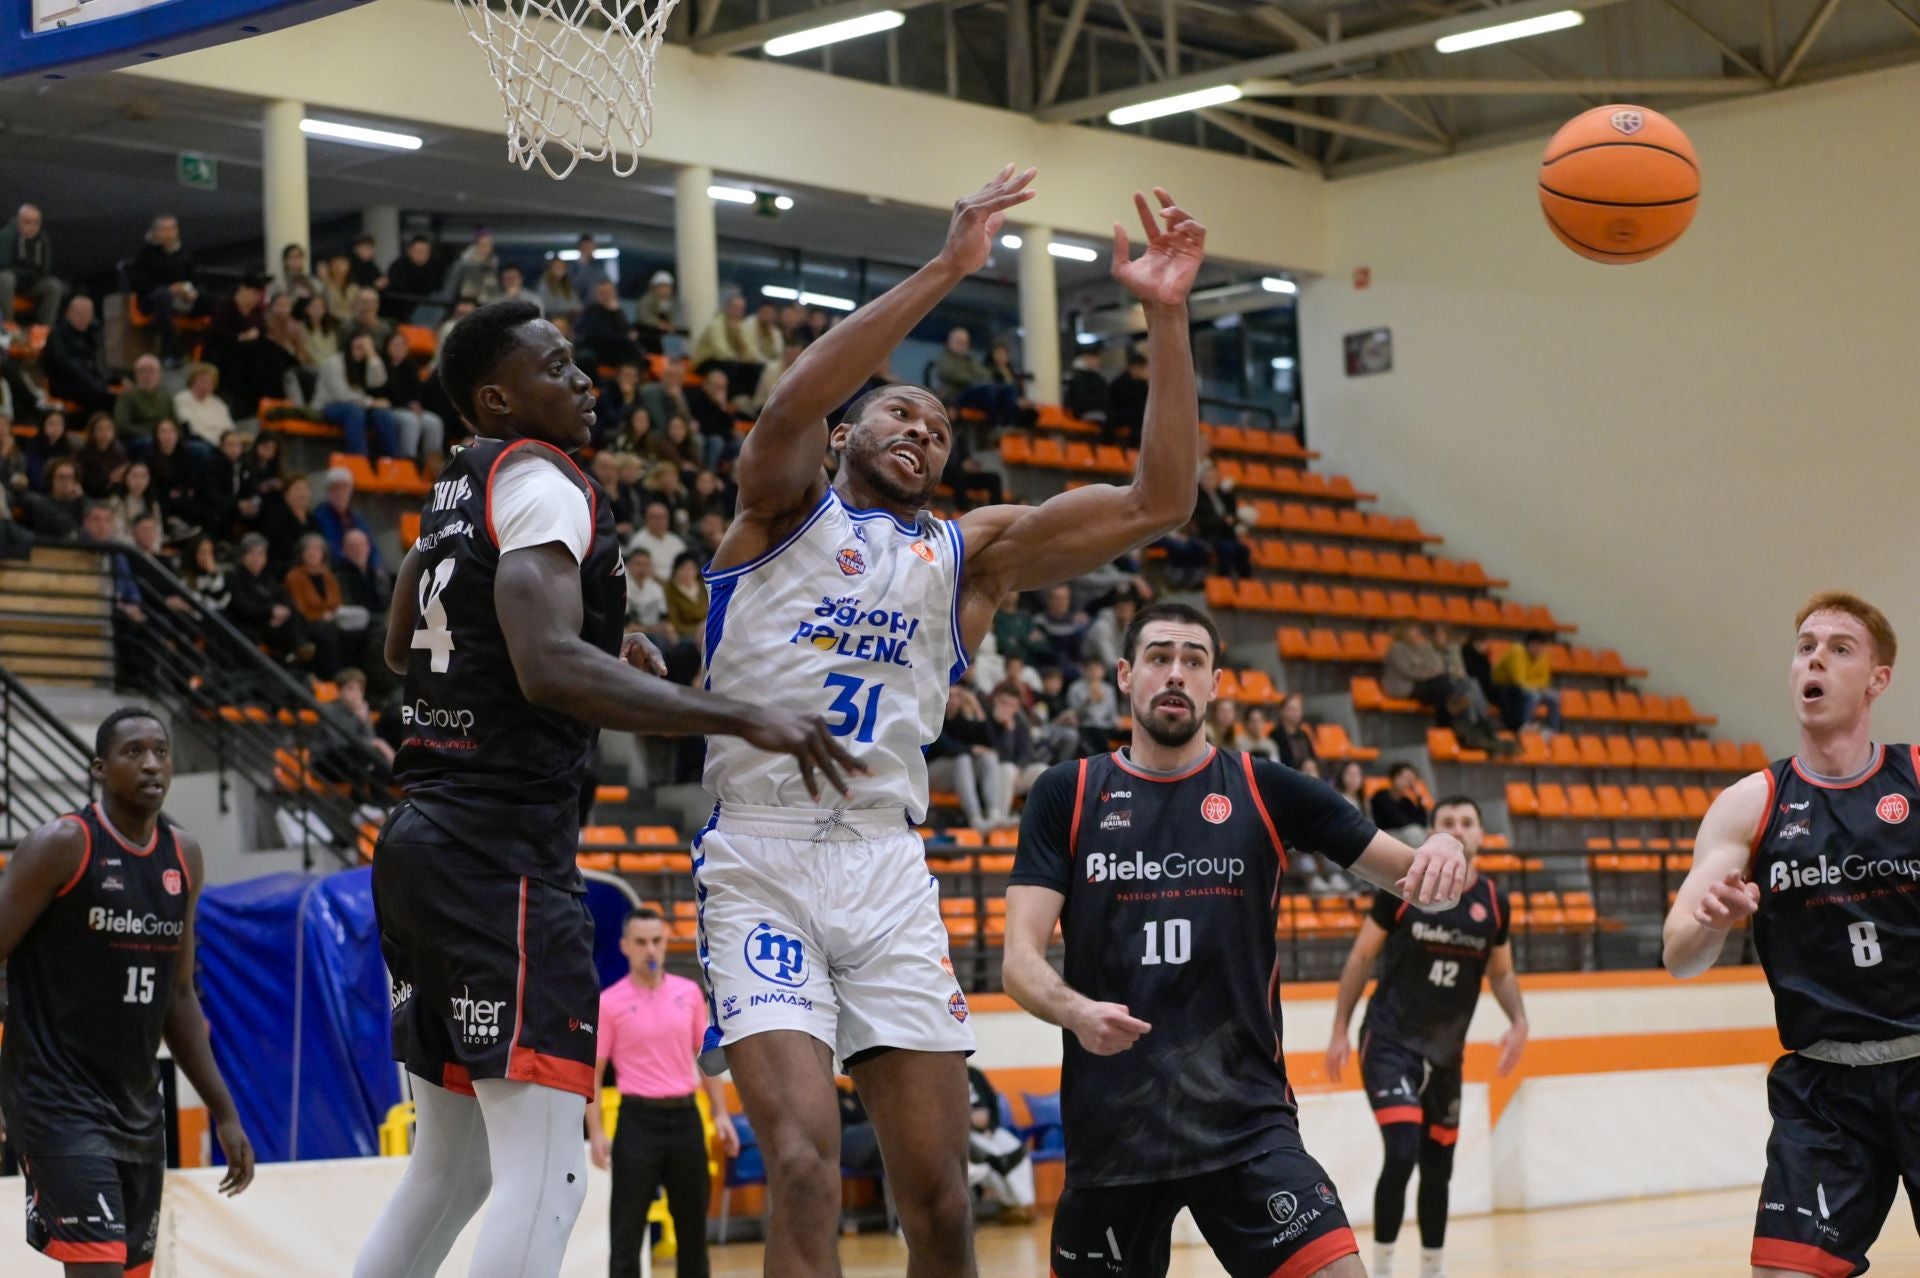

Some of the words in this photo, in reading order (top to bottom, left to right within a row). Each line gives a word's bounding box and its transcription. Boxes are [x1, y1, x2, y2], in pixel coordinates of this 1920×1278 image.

[410, 557, 456, 674] 4
[822, 596, 862, 606] sper
[401, 698, 475, 737] eGroup
[822, 671, 885, 743] 31
[1110, 790, 1132, 800] WIBO
[1100, 818, 1131, 830] IRAURGI
[1087, 850, 1245, 884] BieleGroup
[1770, 854, 1920, 893] BieleGroup
[1116, 891, 1158, 901] PASSION
[1162, 890, 1181, 899] FOR
[1184, 886, 1245, 898] CHALLENGES
[1848, 892, 1867, 903] FOR
[88, 906, 184, 942] BieleGrou
[1141, 918, 1192, 966] 10
[1847, 921, 1883, 968] 8
[123, 966, 156, 1004] 15
[1428, 959, 1459, 987] 42
[463, 1035, 498, 1045] GROUP
[1764, 1201, 1785, 1212] WIBO
[1271, 1208, 1322, 1248] AZKOITIA
